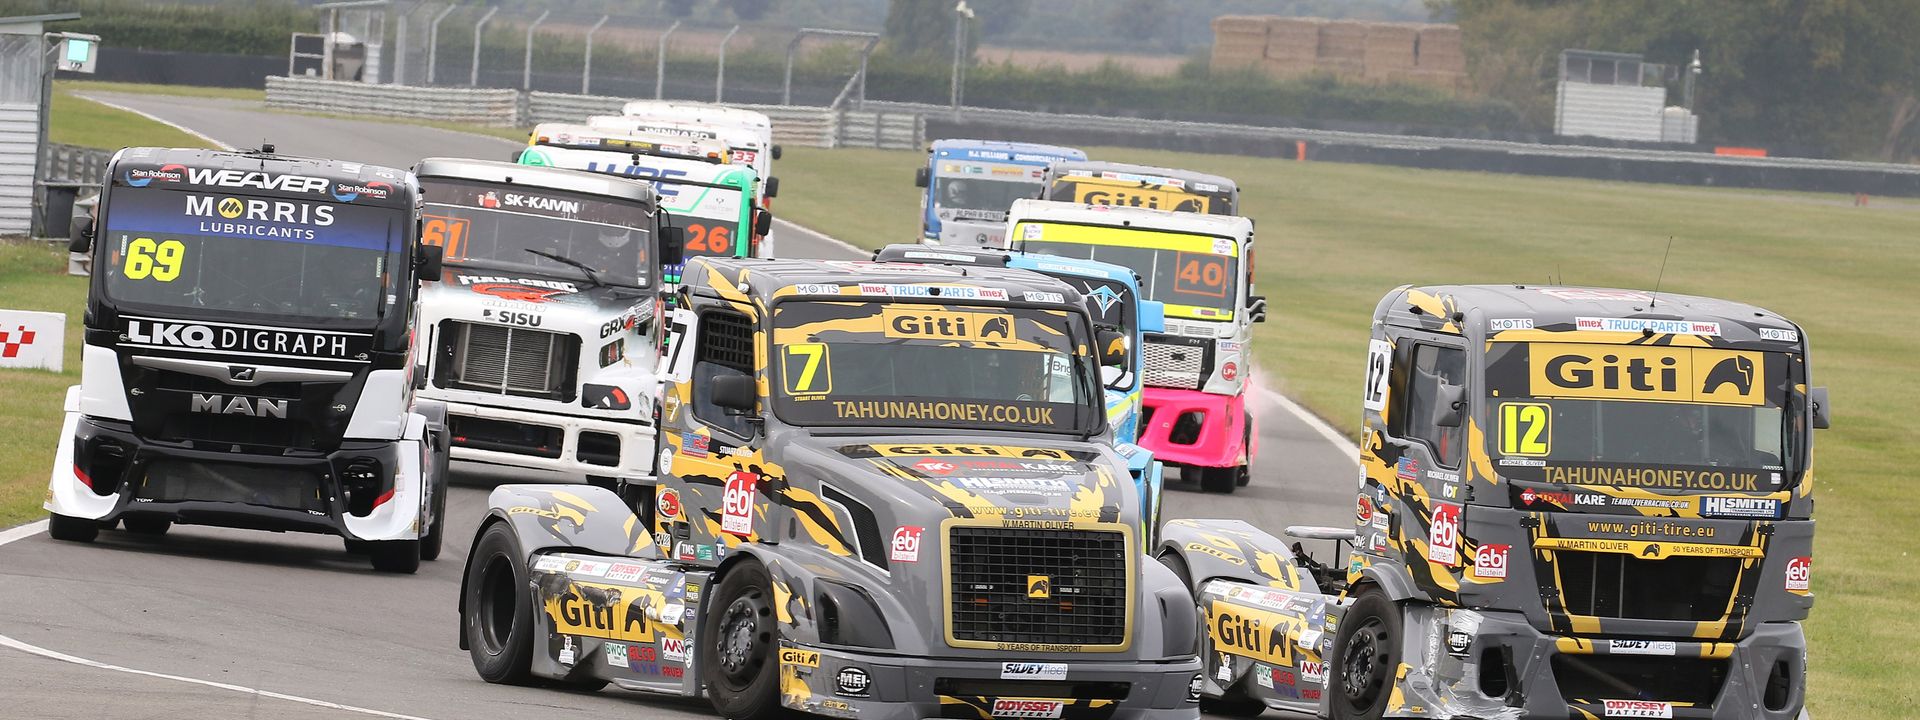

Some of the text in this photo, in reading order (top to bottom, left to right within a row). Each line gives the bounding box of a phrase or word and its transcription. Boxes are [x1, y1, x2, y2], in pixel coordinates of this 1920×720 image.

[643, 128, 709, 140] WINNARD
[132, 169, 181, 180] Stan Robinson
[188, 168, 329, 193] WEAVER
[338, 183, 387, 196] Stan Robinson
[185, 195, 335, 226] MORRIS
[200, 221, 315, 241] LUBRICANTS
[686, 224, 729, 253] 26
[422, 220, 464, 262] 61
[124, 237, 184, 281] 69
[1180, 260, 1223, 287] 40
[458, 275, 578, 292] MAD-CROC
[798, 285, 839, 294] MOTIS
[862, 284, 1003, 299] imex TRUCK PARTS imex
[1025, 292, 1063, 302] MOTIS
[499, 311, 541, 327] SISU
[892, 316, 967, 336] Giti
[1492, 320, 1532, 329] MOTIS
[1577, 318, 1716, 333] imex TRUCK PARTS imex
[127, 320, 347, 356] LKQ DIGRAPH
[1761, 328, 1796, 340] MOTIS
[789, 345, 824, 392] 7
[1365, 351, 1385, 402] 12
[1545, 354, 1677, 393] Giti
[191, 393, 287, 418] MAN
[833, 402, 1054, 425] TAHUNAHONEY.CO.UK
[1504, 405, 1546, 454] 12
[889, 445, 1001, 457] Giti
[1542, 466, 1757, 490] TAHUNAHONEY.CO.UK
[722, 474, 757, 517] febi
[1610, 497, 1689, 509] TEAMOLIVERRACING.CO.UK
[971, 506, 1100, 517] www.giti-tire.eu
[725, 519, 750, 531] bilstein
[1002, 520, 1074, 531] W.MARTIN OLIVER
[1430, 506, 1458, 546] febi
[1588, 521, 1714, 538] www.giti-tire.eu
[892, 527, 921, 551] febi
[1557, 540, 1629, 550] W.MARTIN OLIVER
[1475, 545, 1508, 567] febi
[1716, 548, 1754, 556] TRANSPORT
[560, 592, 614, 631] Giti
[1218, 613, 1260, 652] Giti
[1006, 643, 1029, 651] YEARS
[1042, 644, 1082, 652] TRANSPORT
[783, 652, 805, 663] Giti
[840, 673, 867, 684] MEI
[993, 710, 1053, 718] BATTERY
[994, 701, 1059, 711] ODYSSEY
[1606, 701, 1666, 711] ODYSSEY
